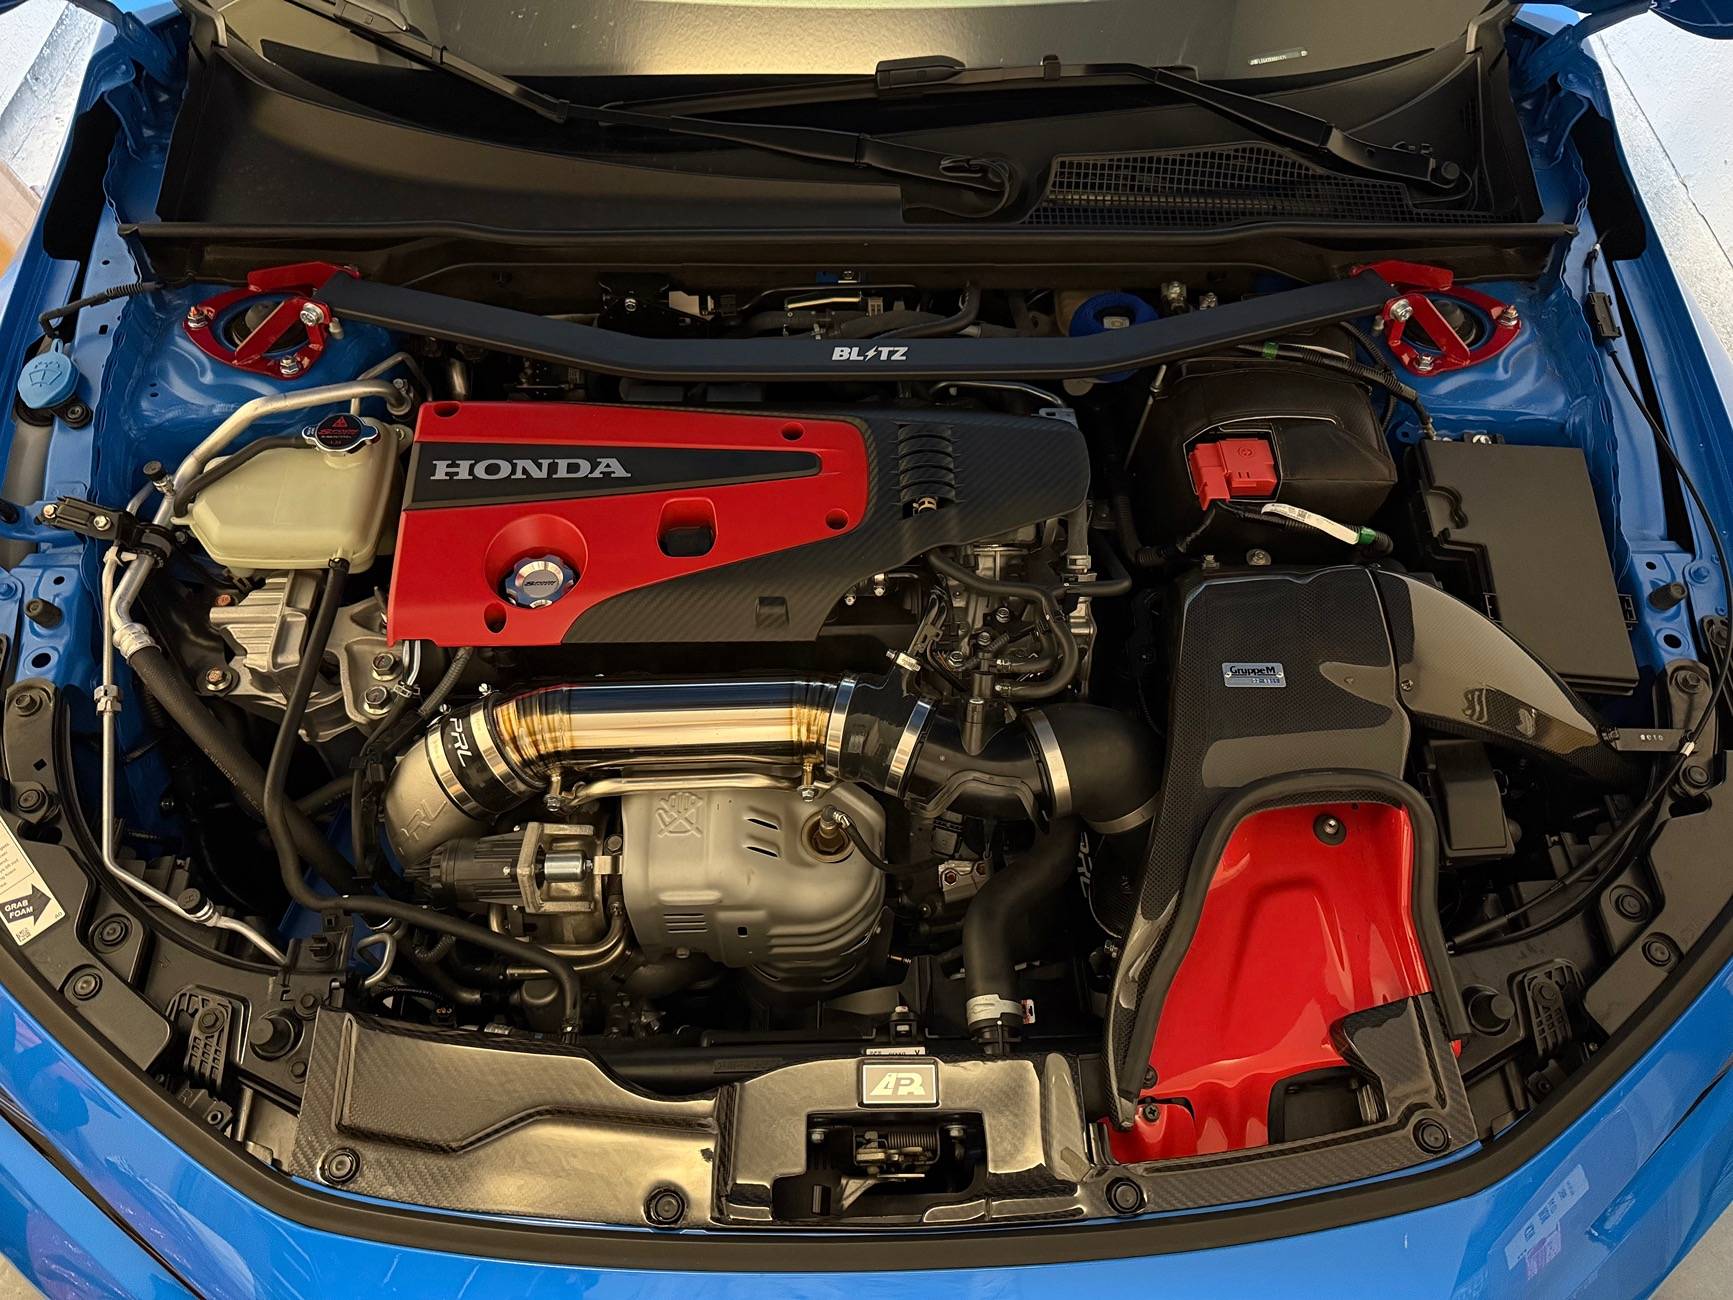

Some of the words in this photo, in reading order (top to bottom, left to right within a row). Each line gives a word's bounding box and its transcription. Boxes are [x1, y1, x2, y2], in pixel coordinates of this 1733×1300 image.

[430, 458, 631, 480] HONDA
[1229, 665, 1276, 676] GruppeM
[446, 717, 473, 768] PRL
[4, 899, 29, 912] GRAB
[9, 906, 34, 919] FOAM
